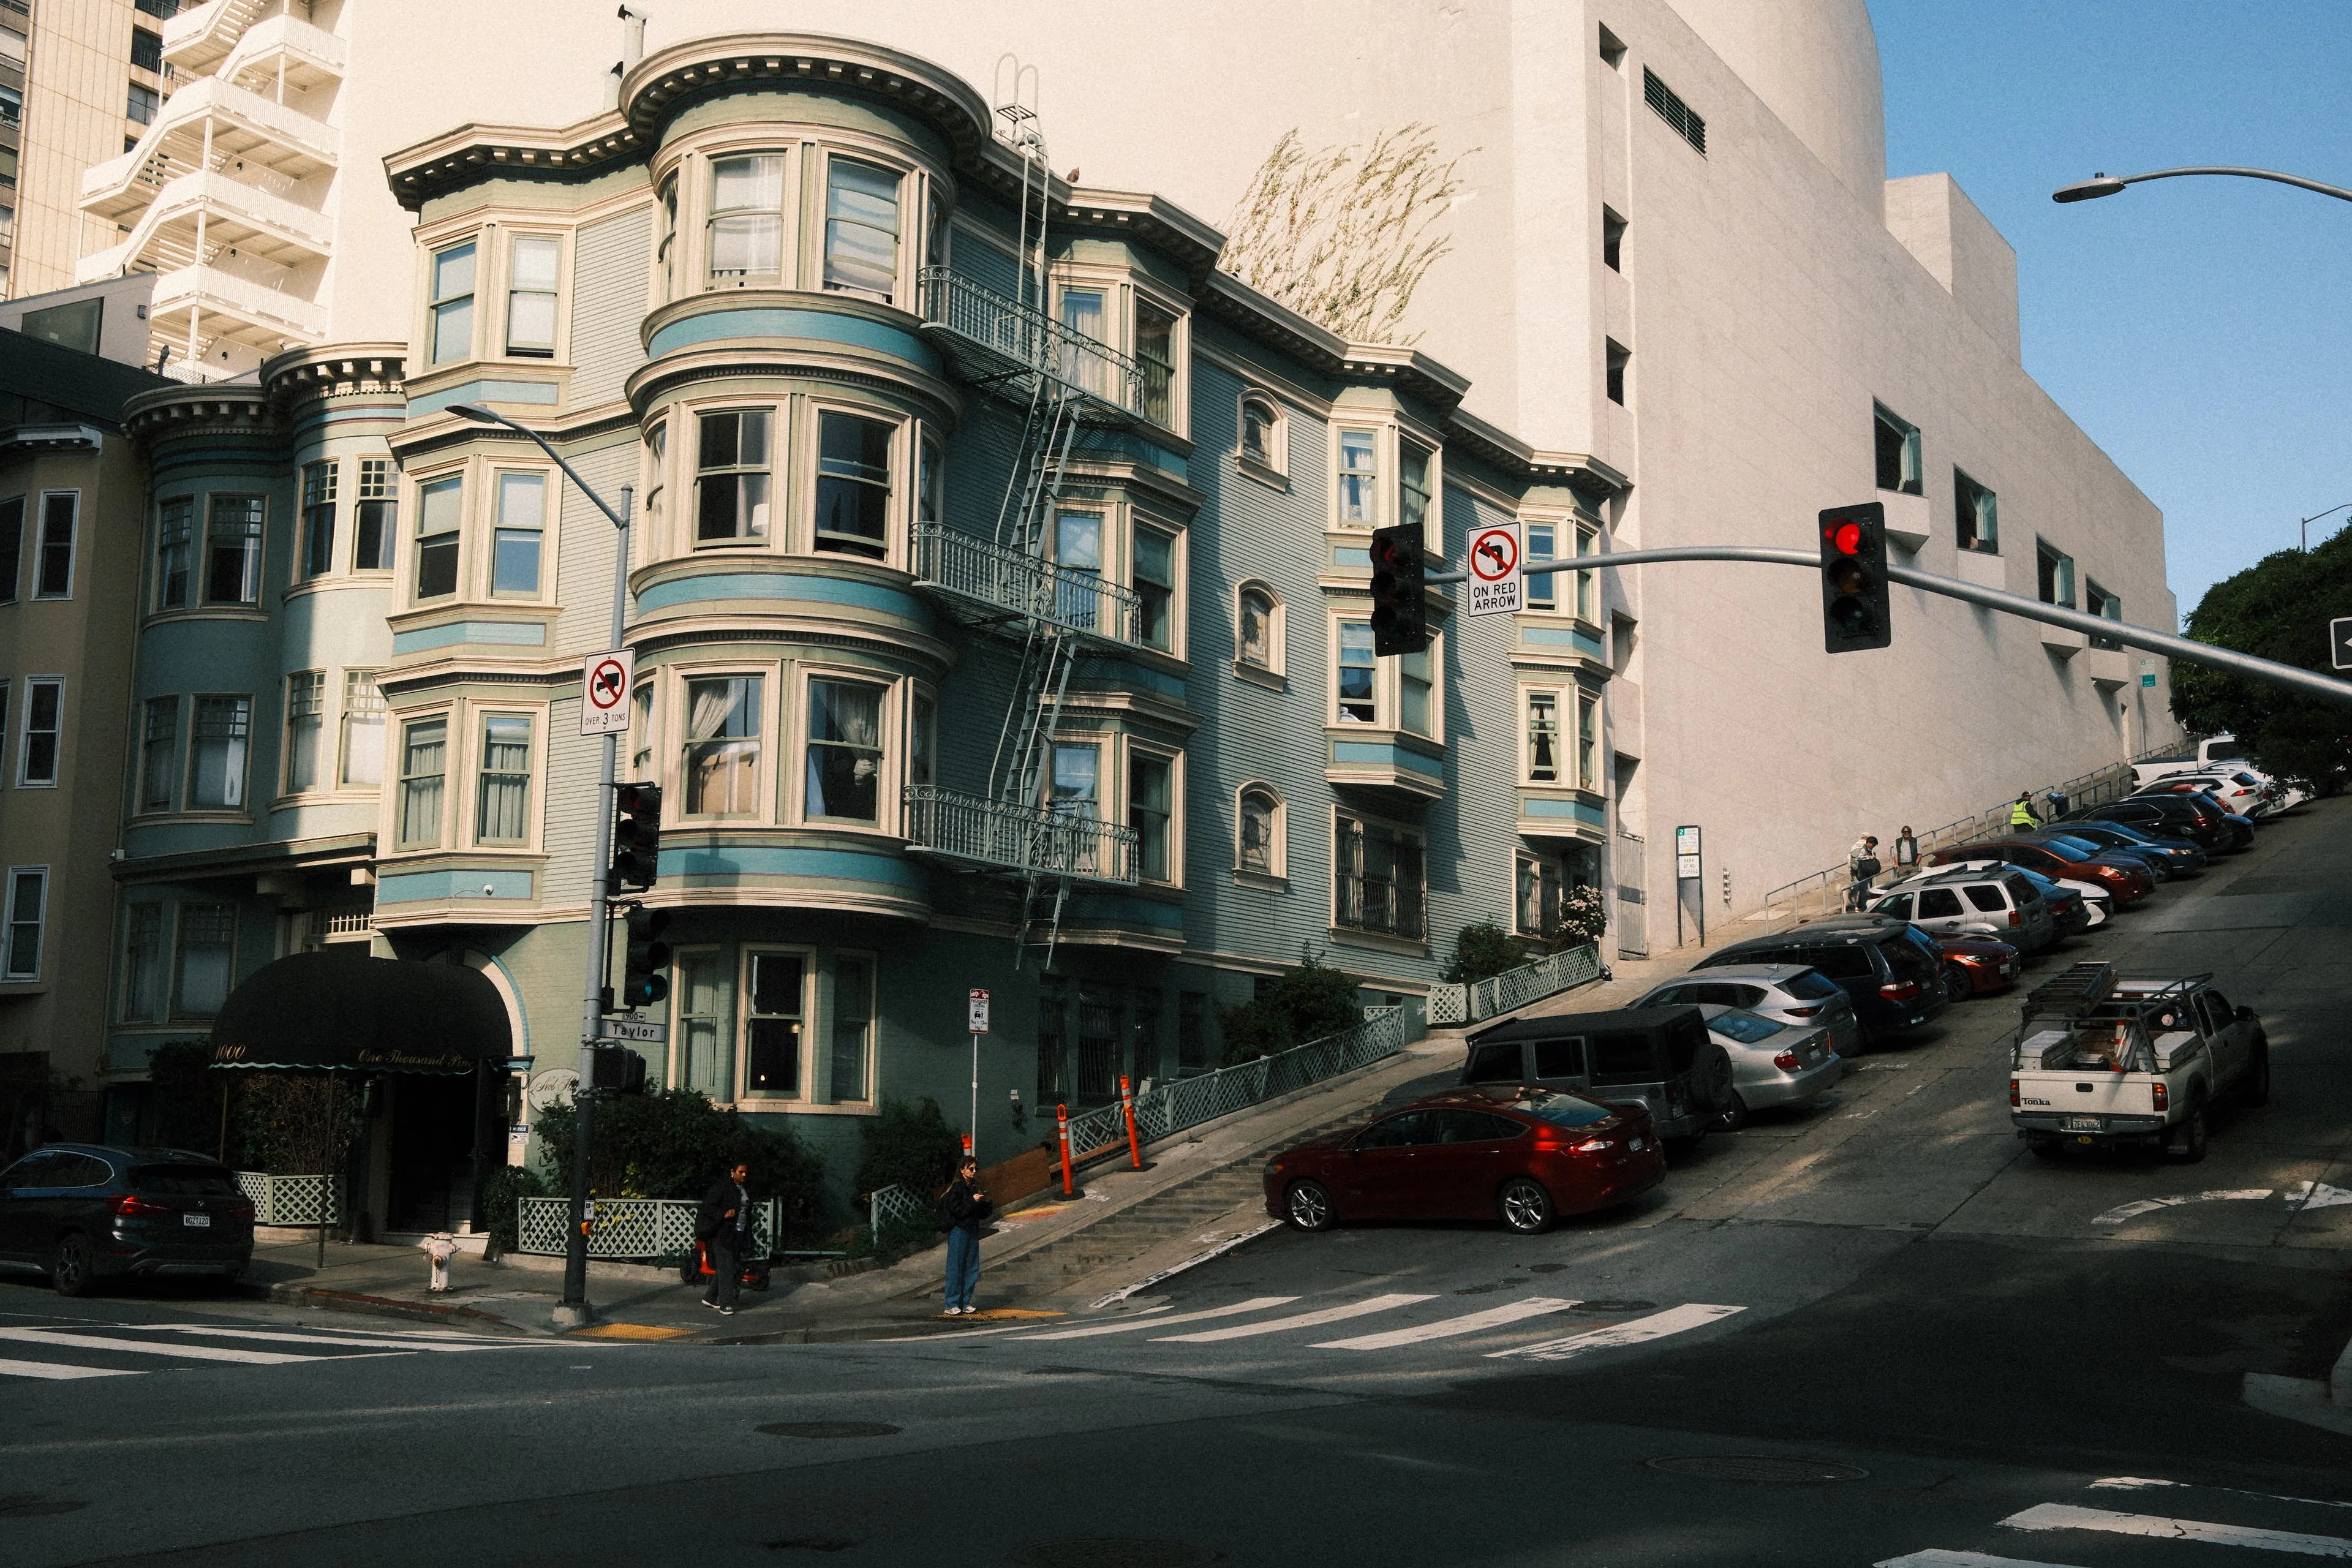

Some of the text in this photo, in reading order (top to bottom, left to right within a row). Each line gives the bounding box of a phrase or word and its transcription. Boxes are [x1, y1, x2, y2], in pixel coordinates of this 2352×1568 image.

[1474, 582, 1515, 598] ON RED
[1474, 595, 1515, 611] ARROW
[586, 712, 626, 725] OVER 3 TONS
[613, 1023, 655, 1038] Taylor
[216, 1044, 246, 1060] 1000
[359, 1048, 383, 1063] One
[385, 1049, 446, 1066] Thousand
[186, 1216, 209, 1225] 8GZT120
